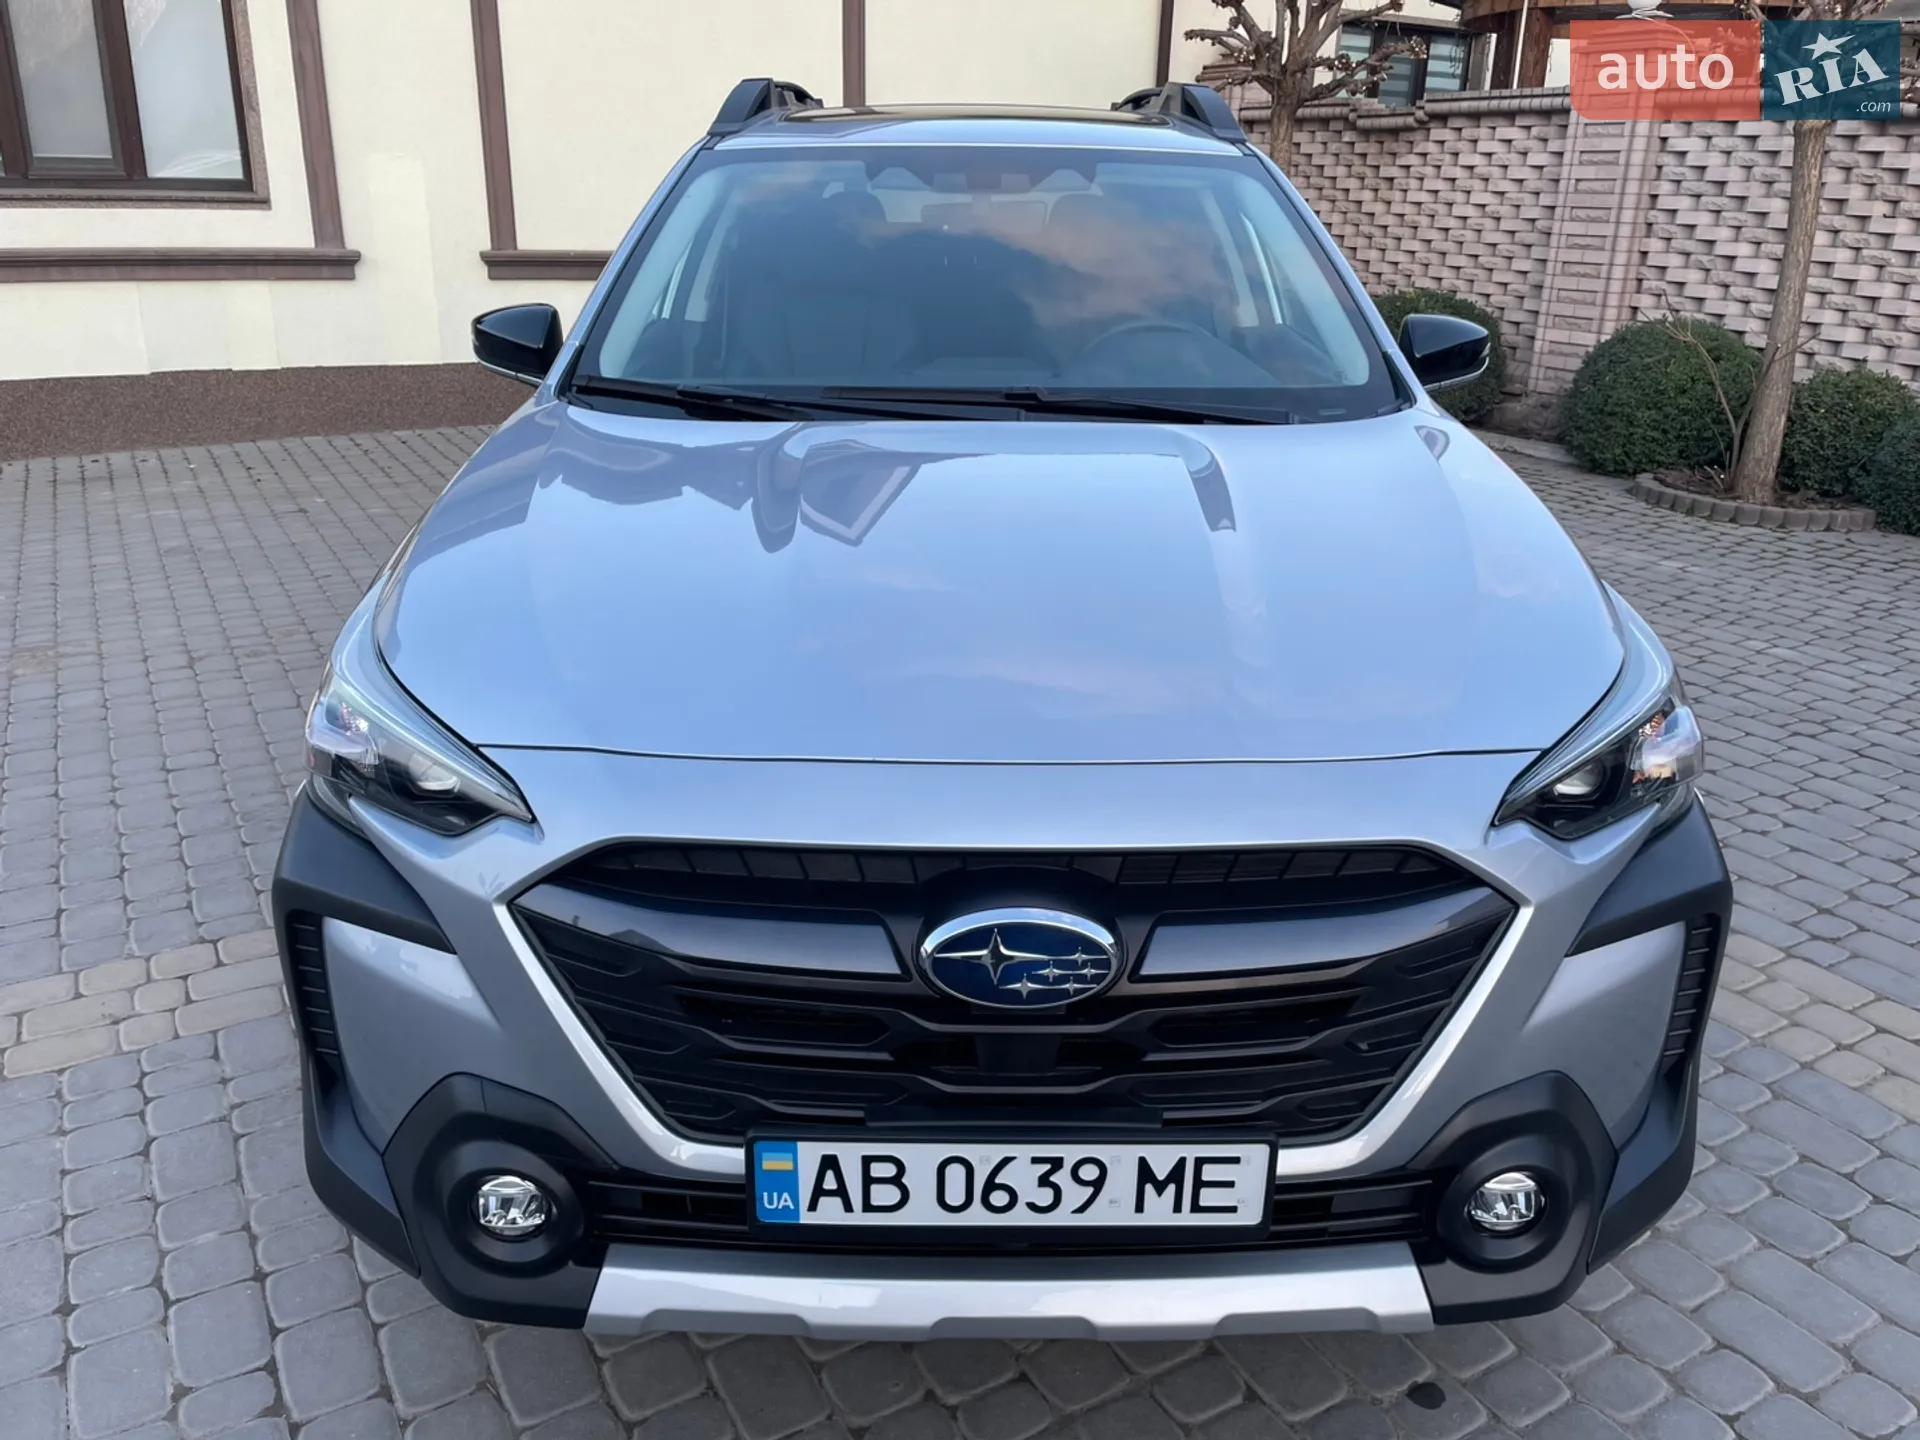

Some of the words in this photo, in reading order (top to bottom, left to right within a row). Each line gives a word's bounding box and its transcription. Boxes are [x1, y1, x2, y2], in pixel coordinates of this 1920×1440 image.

[763, 1191, 795, 1211] UA
[806, 1153, 911, 1214] AB
[935, 1154, 1108, 1215] 0639
[1134, 1155, 1242, 1214] ME
